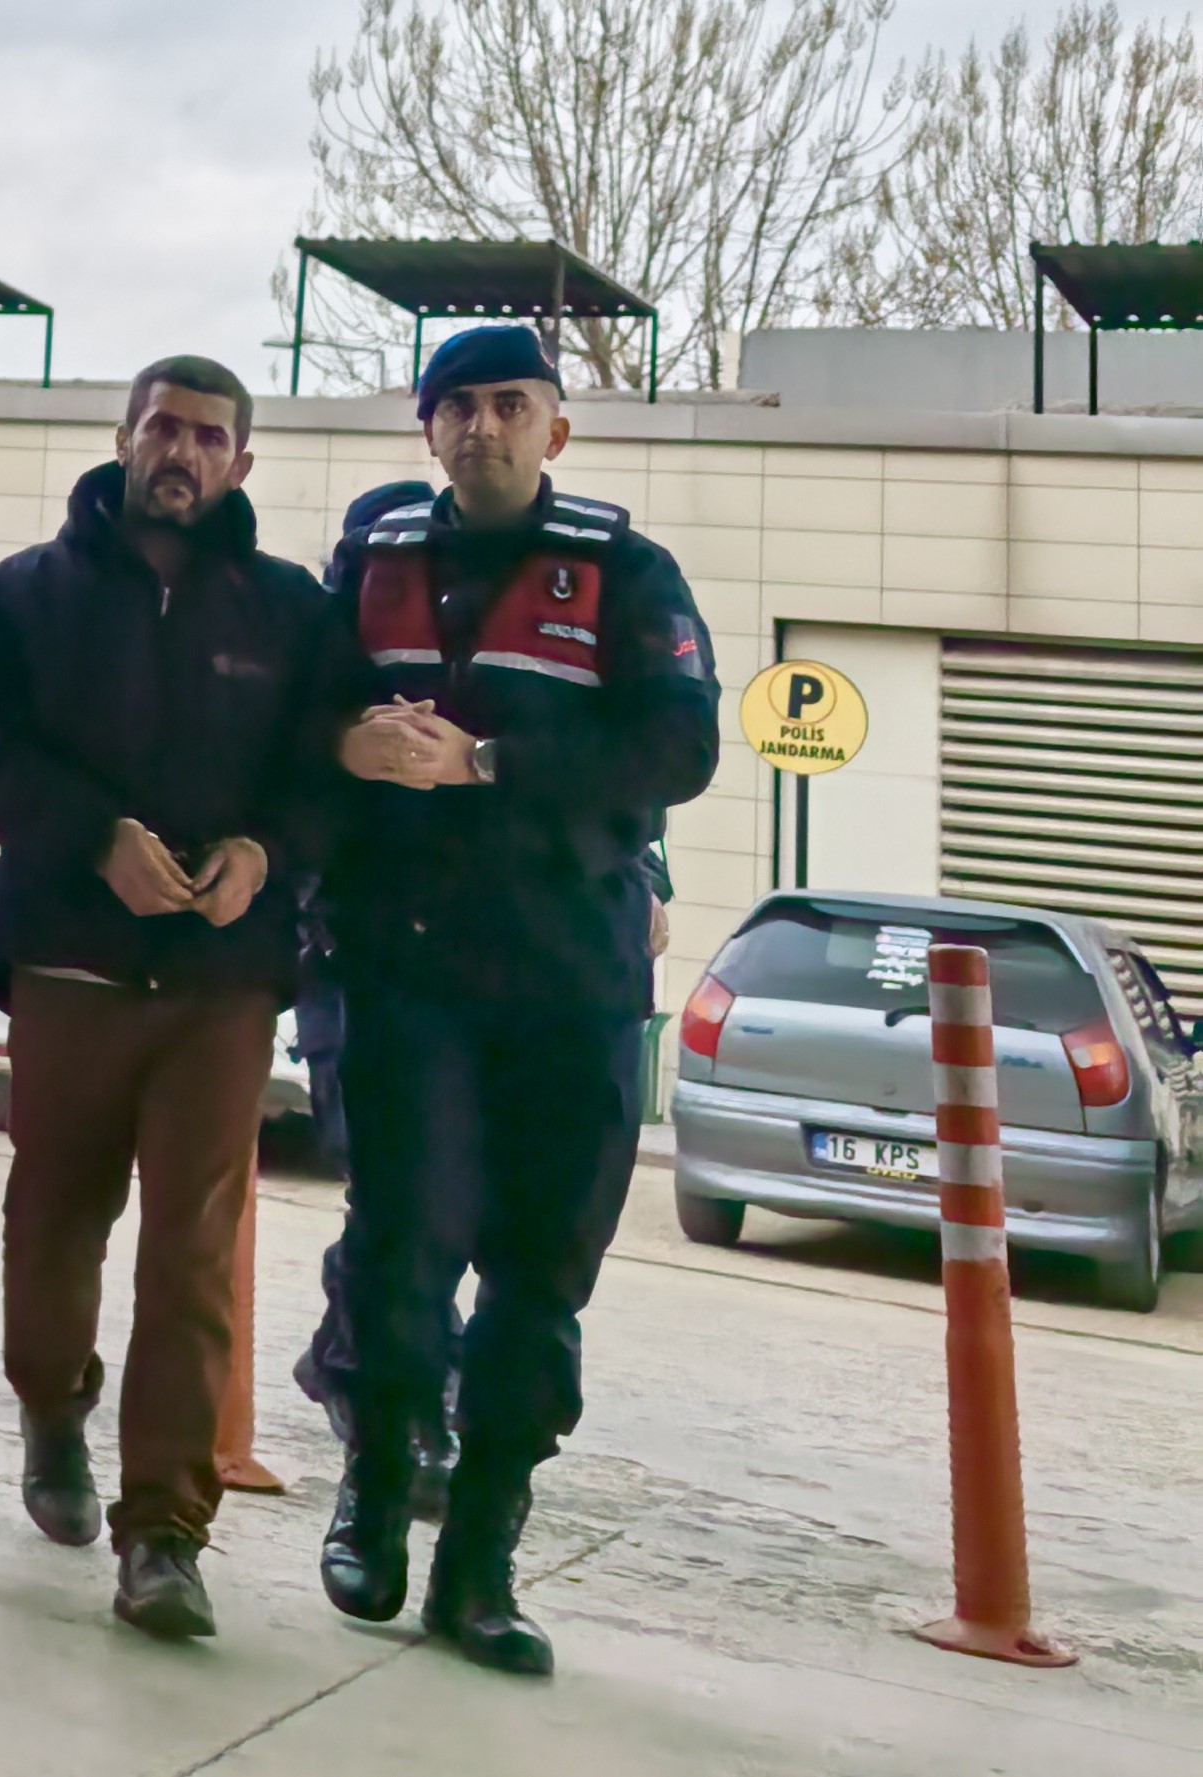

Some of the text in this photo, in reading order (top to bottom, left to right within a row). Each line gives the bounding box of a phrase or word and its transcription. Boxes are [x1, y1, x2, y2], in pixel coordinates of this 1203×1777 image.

[787, 673, 824, 719] P
[759, 740, 845, 761] JANDARMA
[830, 1136, 919, 1170] 16 KPS
